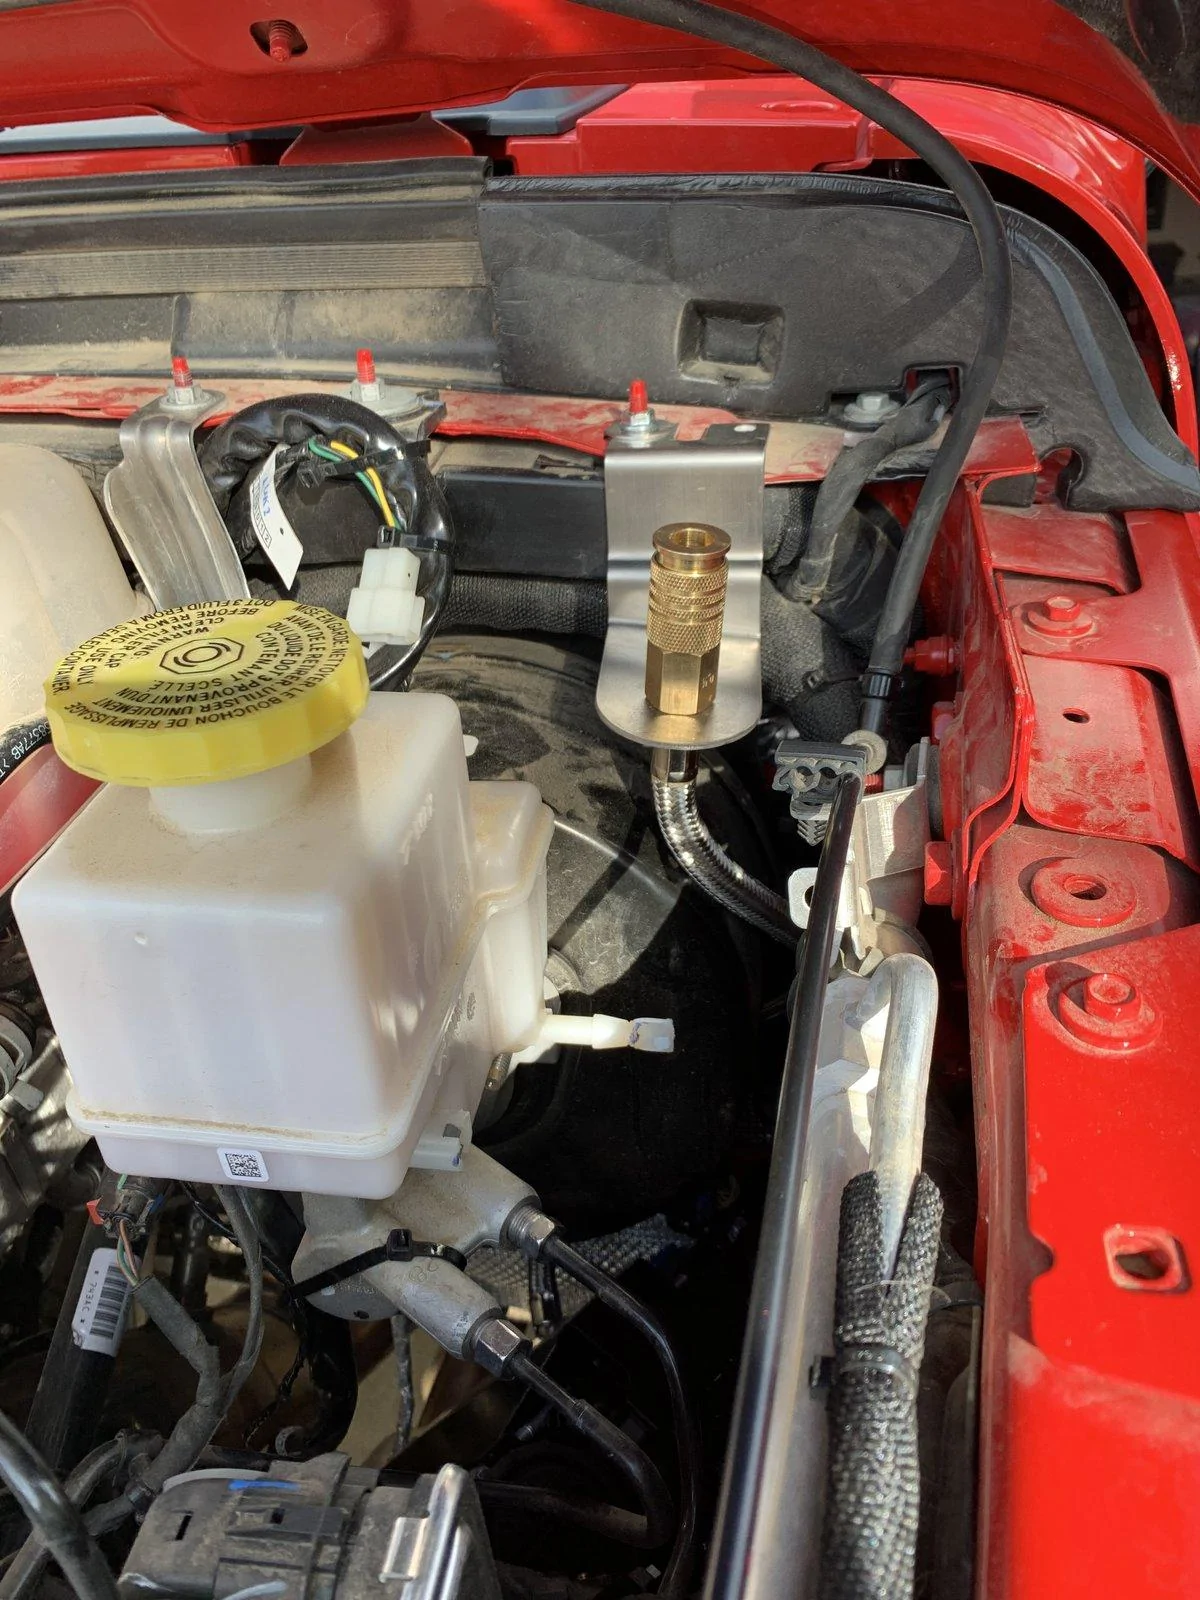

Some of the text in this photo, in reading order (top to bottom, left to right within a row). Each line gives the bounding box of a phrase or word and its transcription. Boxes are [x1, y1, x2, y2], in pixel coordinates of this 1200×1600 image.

[187, 600, 231, 612] FLUID
[246, 599, 277, 607] DOT
[293, 604, 323, 617] MISE
[140, 606, 185, 621] FROM
[196, 607, 260, 618] BEFORE
[316, 611, 335, 625] EN
[267, 621, 284, 634] DU
[284, 614, 320, 636] AVANT
[79, 624, 128, 651] SEALED
[104, 617, 225, 669] CLEAN FILLER CAP
[131, 627, 209, 660] WARNING:
[278, 628, 304, 658] LIQUIDE
[306, 633, 326, 645] DE
[85, 647, 113, 663] USE
[233, 631, 280, 683] CONTENANT
[308, 644, 326, 652] LE
[77, 665, 97, 686] ONLY
[268, 659, 297, 677] DOT
[304, 648, 348, 688] NETTOYER
[116, 686, 150, 702] D'UN
[150, 680, 261, 704] PROVENANT
[200, 685, 277, 713] UTILISER
[281, 687, 304, 699] LE
[64, 701, 160, 729] REMPLISSAGE
[92, 696, 193, 717] UNIQUEMENT
[195, 696, 282, 725] BOUCHON
[166, 718, 189, 728] DE
